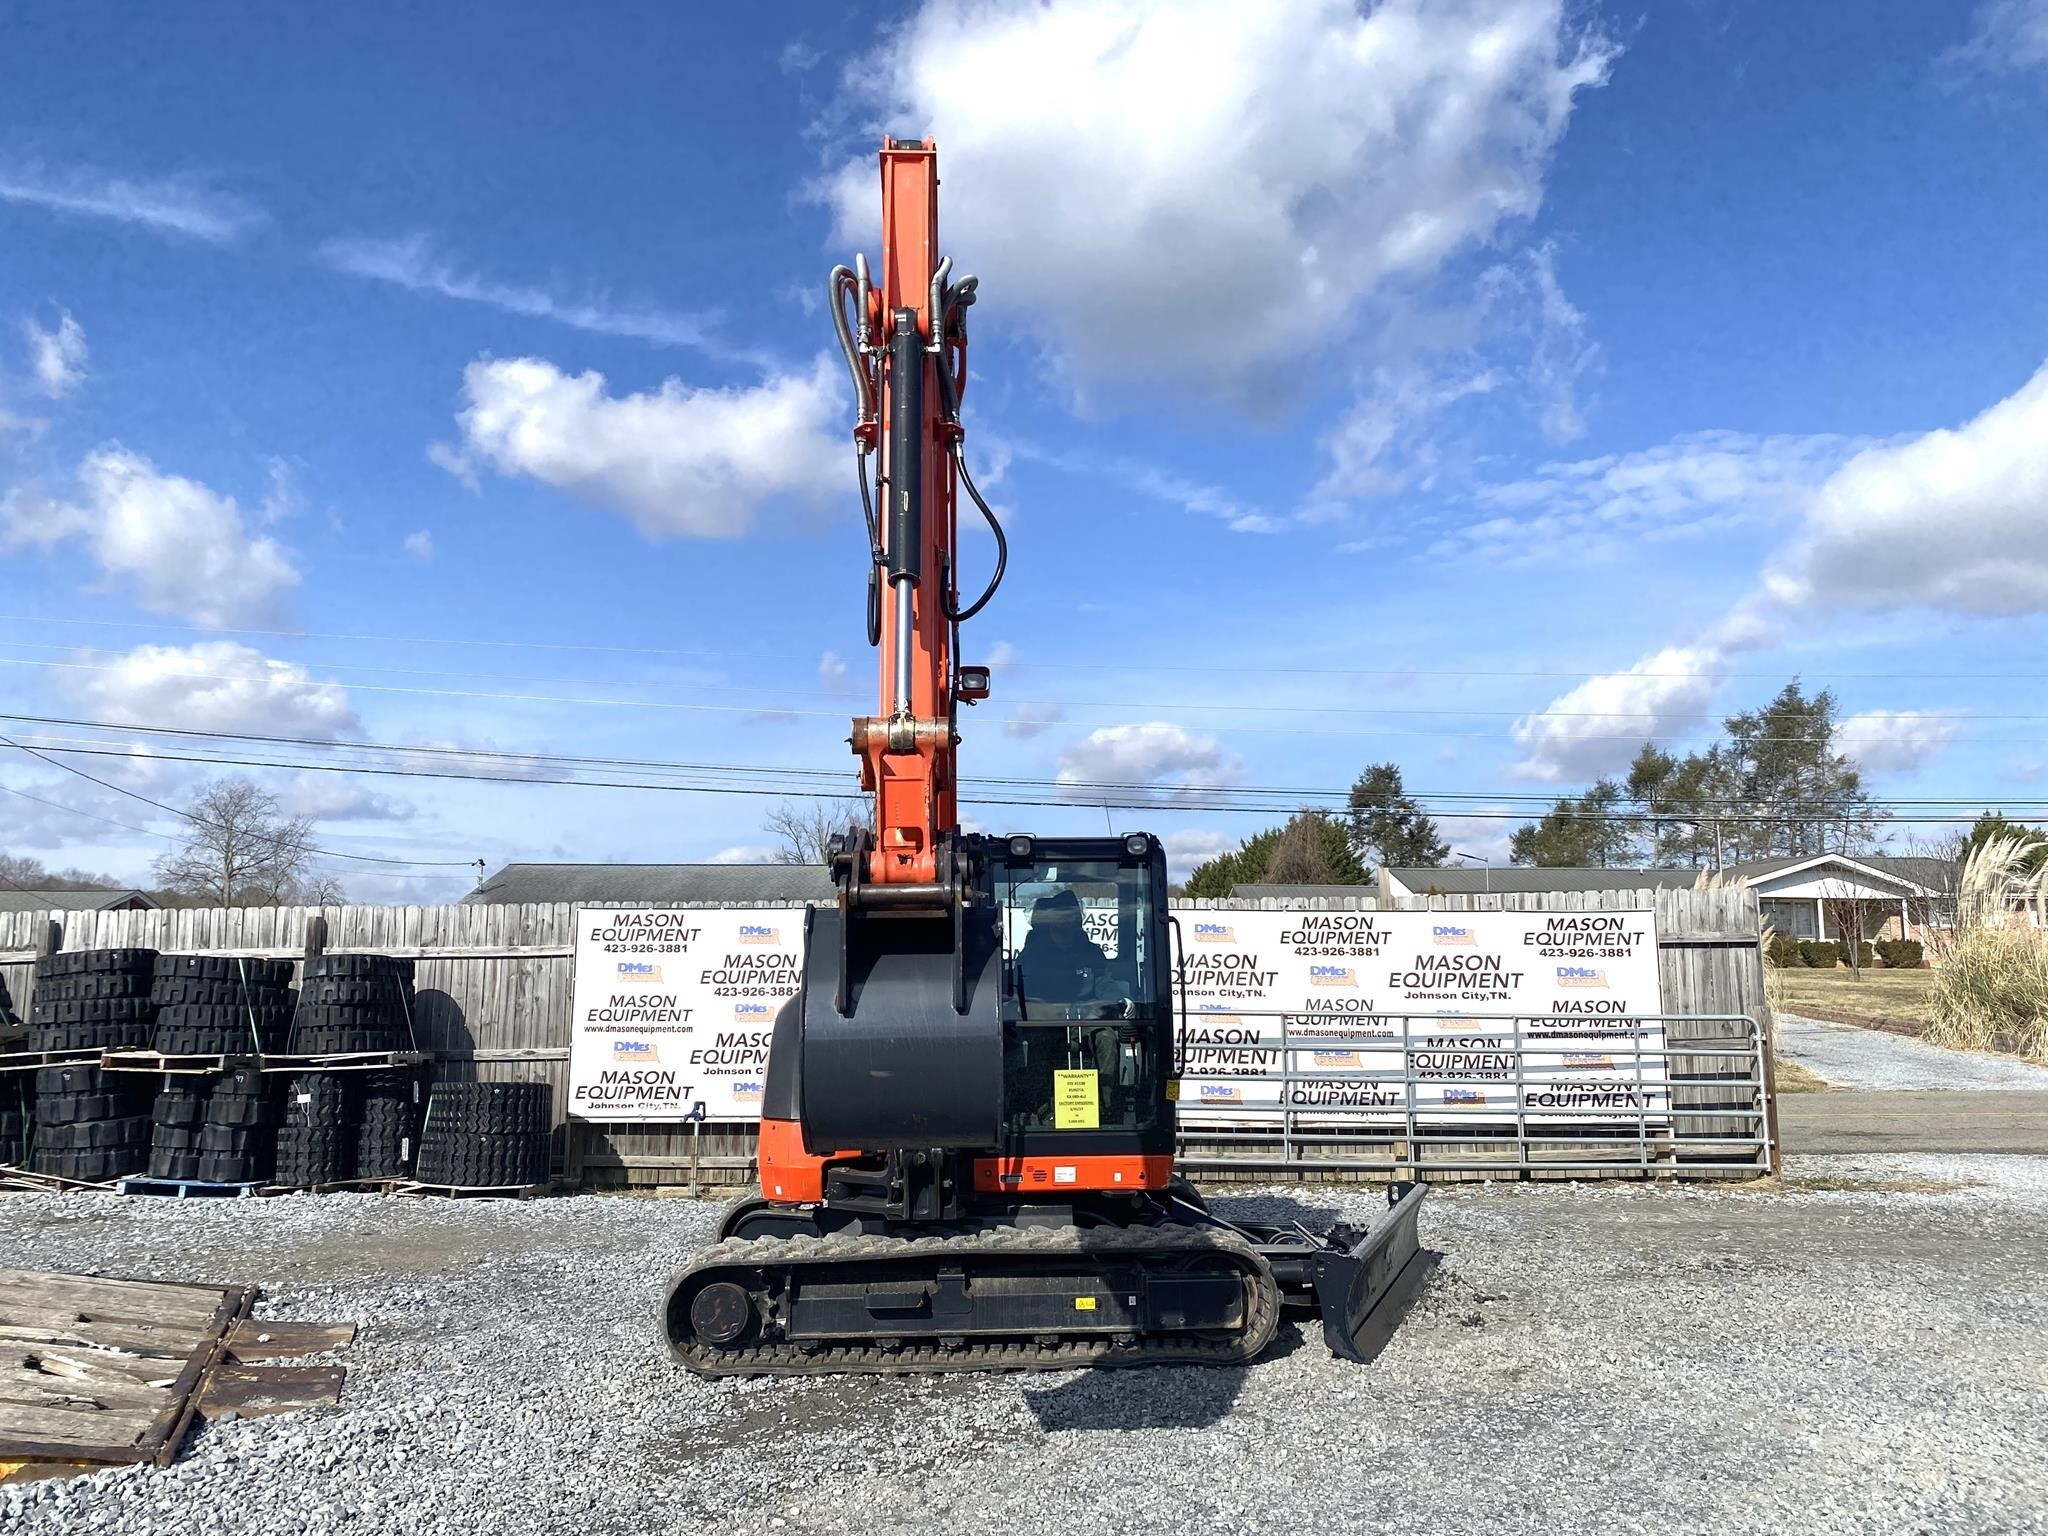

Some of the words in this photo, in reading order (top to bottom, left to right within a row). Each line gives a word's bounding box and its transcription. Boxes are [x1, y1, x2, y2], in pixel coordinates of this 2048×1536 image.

[613, 914, 684, 927] MASON
[1302, 916, 1373, 930] MASON
[1547, 918, 1624, 931] MASON
[591, 928, 701, 941] EQUIPMENT
[1280, 931, 1392, 945] EQUIPMENT
[1524, 932, 1644, 946] EQUIPMENT
[604, 944, 687, 953] 423-926-3881
[1294, 947, 1380, 956] 423-926-3881
[1539, 948, 1632, 957] 423-926-3881
[724, 954, 797, 968] MASON
[1176, 954, 1257, 969] MASON
[1415, 955, 1501, 970] MASON
[700, 970, 803, 984] EQUIPMEN
[1172, 970, 1279, 986] QUIPMENT
[1389, 973, 1524, 988] EQUIPMENT
[609, 995, 677, 1007] MASON
[1404, 991, 1457, 999] Johnson
[1306, 999, 1373, 1012] MASON
[1552, 1000, 1626, 1013] MASON
[588, 1009, 693, 1022] EQUIPMENT
[584, 1025, 693, 1035] www.dmasonequipment.com
[1176, 1028, 1260, 1044] MASON
[1288, 1028, 1394, 1039] ww.dmasonequipment.com
[1527, 1031, 1648, 1040] www.dmasonequipment.cm
[716, 1032, 772, 1047] MASO
[690, 1049, 768, 1064] EQUIPM
[703, 1067, 751, 1075] Johnson
[600, 1071, 676, 1085] MASON
[575, 1085, 694, 1100] EQUIPMENT
[1525, 1093, 1656, 1107] EQUIPMENT
